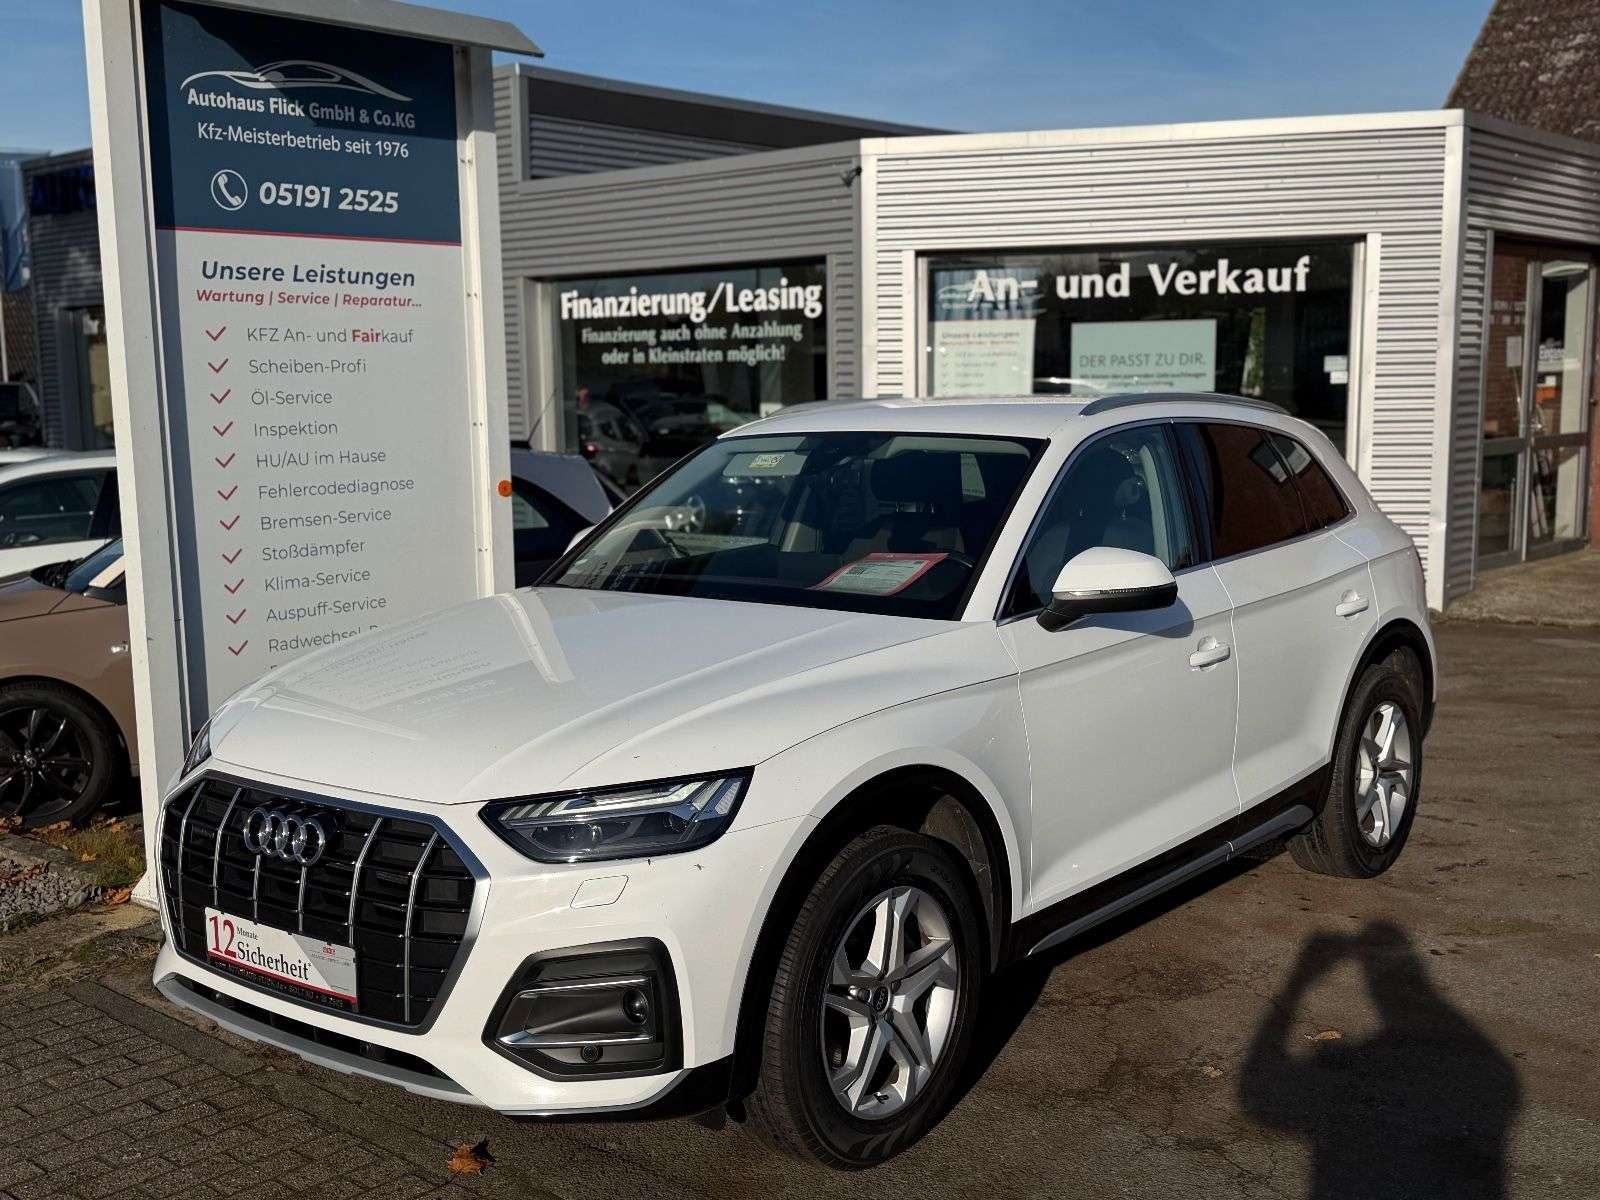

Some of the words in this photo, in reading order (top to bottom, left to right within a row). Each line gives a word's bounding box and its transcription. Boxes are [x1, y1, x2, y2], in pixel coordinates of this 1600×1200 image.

[187, 88, 265, 113] Autohaus
[269, 98, 305, 117] Flick
[309, 102, 355, 123] GmbH
[359, 108, 370, 124] &
[373, 109, 416, 129] Co.KG
[197, 122, 341, 152] Kfz-Meisterbetrieb
[345, 138, 372, 155] seit
[374, 140, 409, 158] 1976
[258, 181, 331, 209] 05191
[338, 187, 399, 214] 2525
[201, 260, 285, 282] Unsere
[292, 264, 416, 289] Leistungen
[967, 270, 1037, 302] An-
[1056, 264, 1131, 299] und
[1147, 255, 1311, 297] Verkauf
[196, 289, 265, 307] Wartung
[277, 291, 330, 306] Service
[342, 293, 422, 309] Reparatur...
[560, 276, 823, 323] Finanzierung/Leasing
[246, 327, 280, 343] KFZ
[283, 328, 313, 344] An-
[316, 328, 348, 344] und
[351, 328, 416, 344] Fairkauf
[581, 326, 656, 345] Finanzierung
[659, 325, 691, 342] auch
[694, 323, 727, 341] ohne
[731, 320, 803, 342] Anzahlung
[248, 358, 367, 374] Scheiben-Profi
[601, 350, 630, 365] oder
[632, 347, 646, 363] in
[726, 344, 786, 366] möglich!
[1079, 354, 1106, 368] DER
[1110, 353, 1151, 367] PASST
[1155, 353, 1176, 366] ZU
[1179, 352, 1207, 366] DIR.
[251, 388, 333, 405] Öl-Service
[254, 421, 338, 440] Inspektion
[256, 452, 310, 469] HU/AU
[314, 451, 335, 465] im
[339, 450, 387, 464] Hause
[258, 478, 415, 500] Fehlercodediagnose
[260, 507, 392, 531] Bremsen-Service
[262, 539, 366, 561] Stoßdämpfer
[264, 568, 371, 592] Klima-Service
[266, 596, 388, 623] Auspuff-Service
[209, 915, 236, 957] 12
[236, 926, 259, 941] Monate
